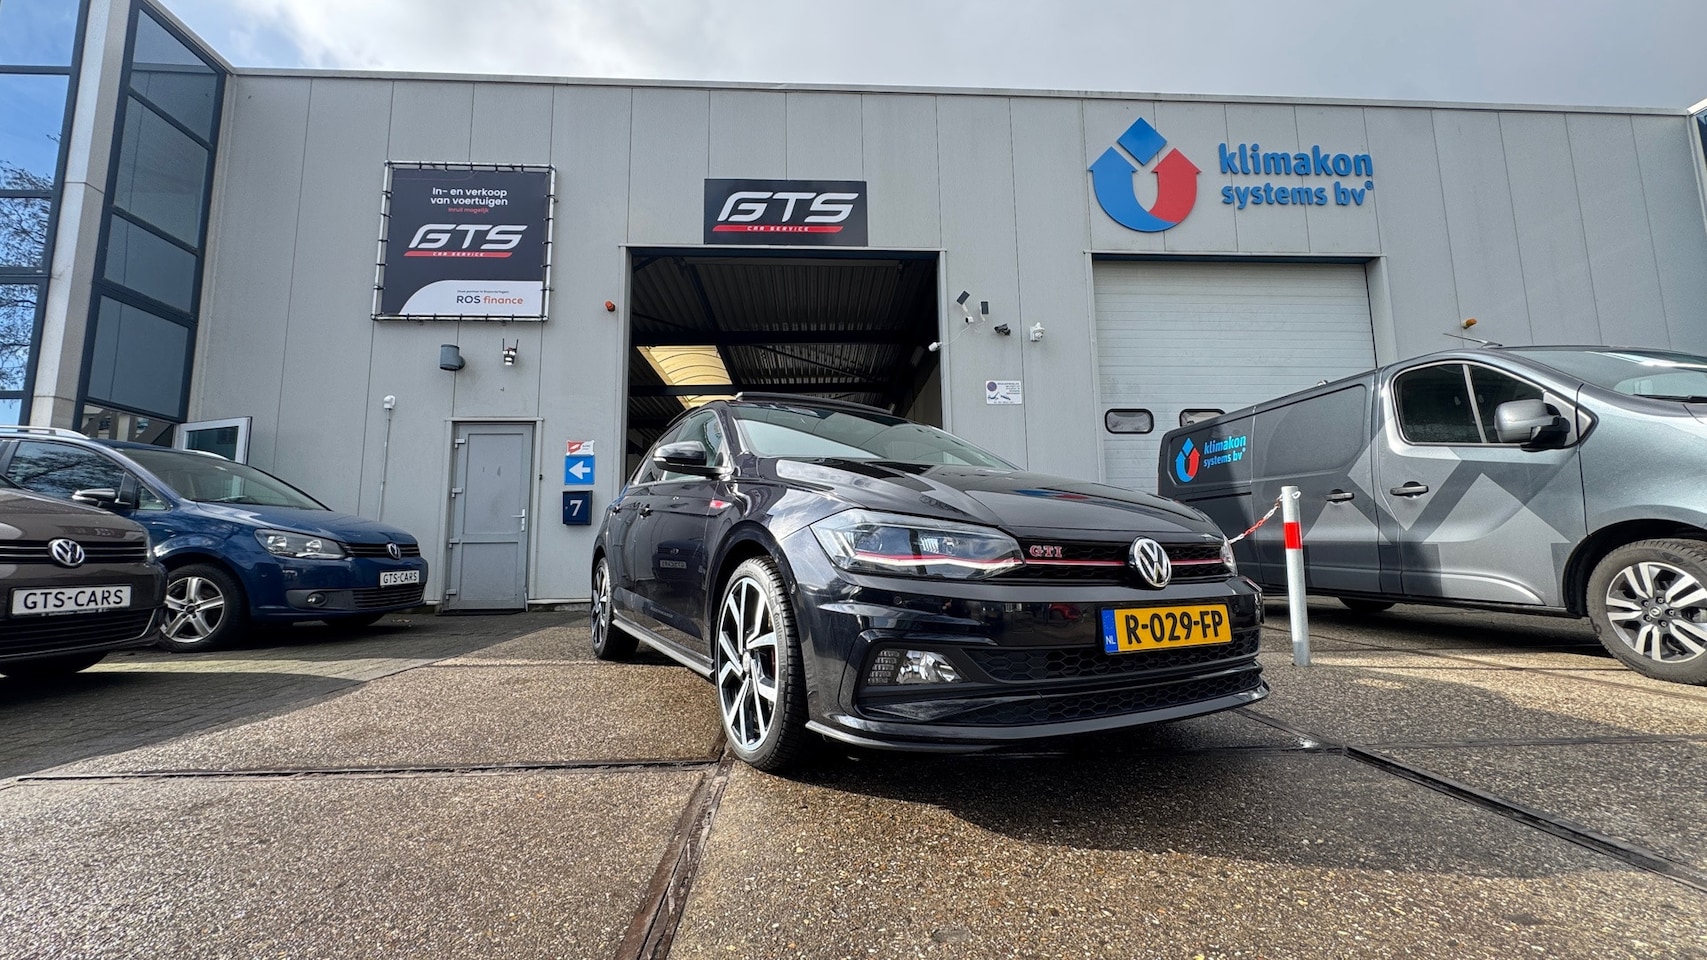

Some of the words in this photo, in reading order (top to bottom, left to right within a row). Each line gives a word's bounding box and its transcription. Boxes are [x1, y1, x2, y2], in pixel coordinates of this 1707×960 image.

[1218, 142, 1373, 177] klimakon
[450, 188, 463, 196] en
[465, 188, 508, 198] verkoop
[452, 196, 508, 208] voertuigen
[1221, 182, 1328, 210] systems
[717, 191, 859, 223] GTS
[408, 223, 528, 250] GTS
[456, 295, 481, 304] ROS
[483, 295, 524, 305] finance
[1203, 435, 1247, 455] klimakon
[1203, 453, 1232, 469] systems
[569, 499, 583, 517] 7
[1029, 545, 1063, 558] GTI
[383, 572, 417, 584] GTS-CARS
[23, 589, 123, 610] GTS-CARS
[1105, 635, 1116, 645] NL
[1124, 610, 1223, 645] R-029-FP
